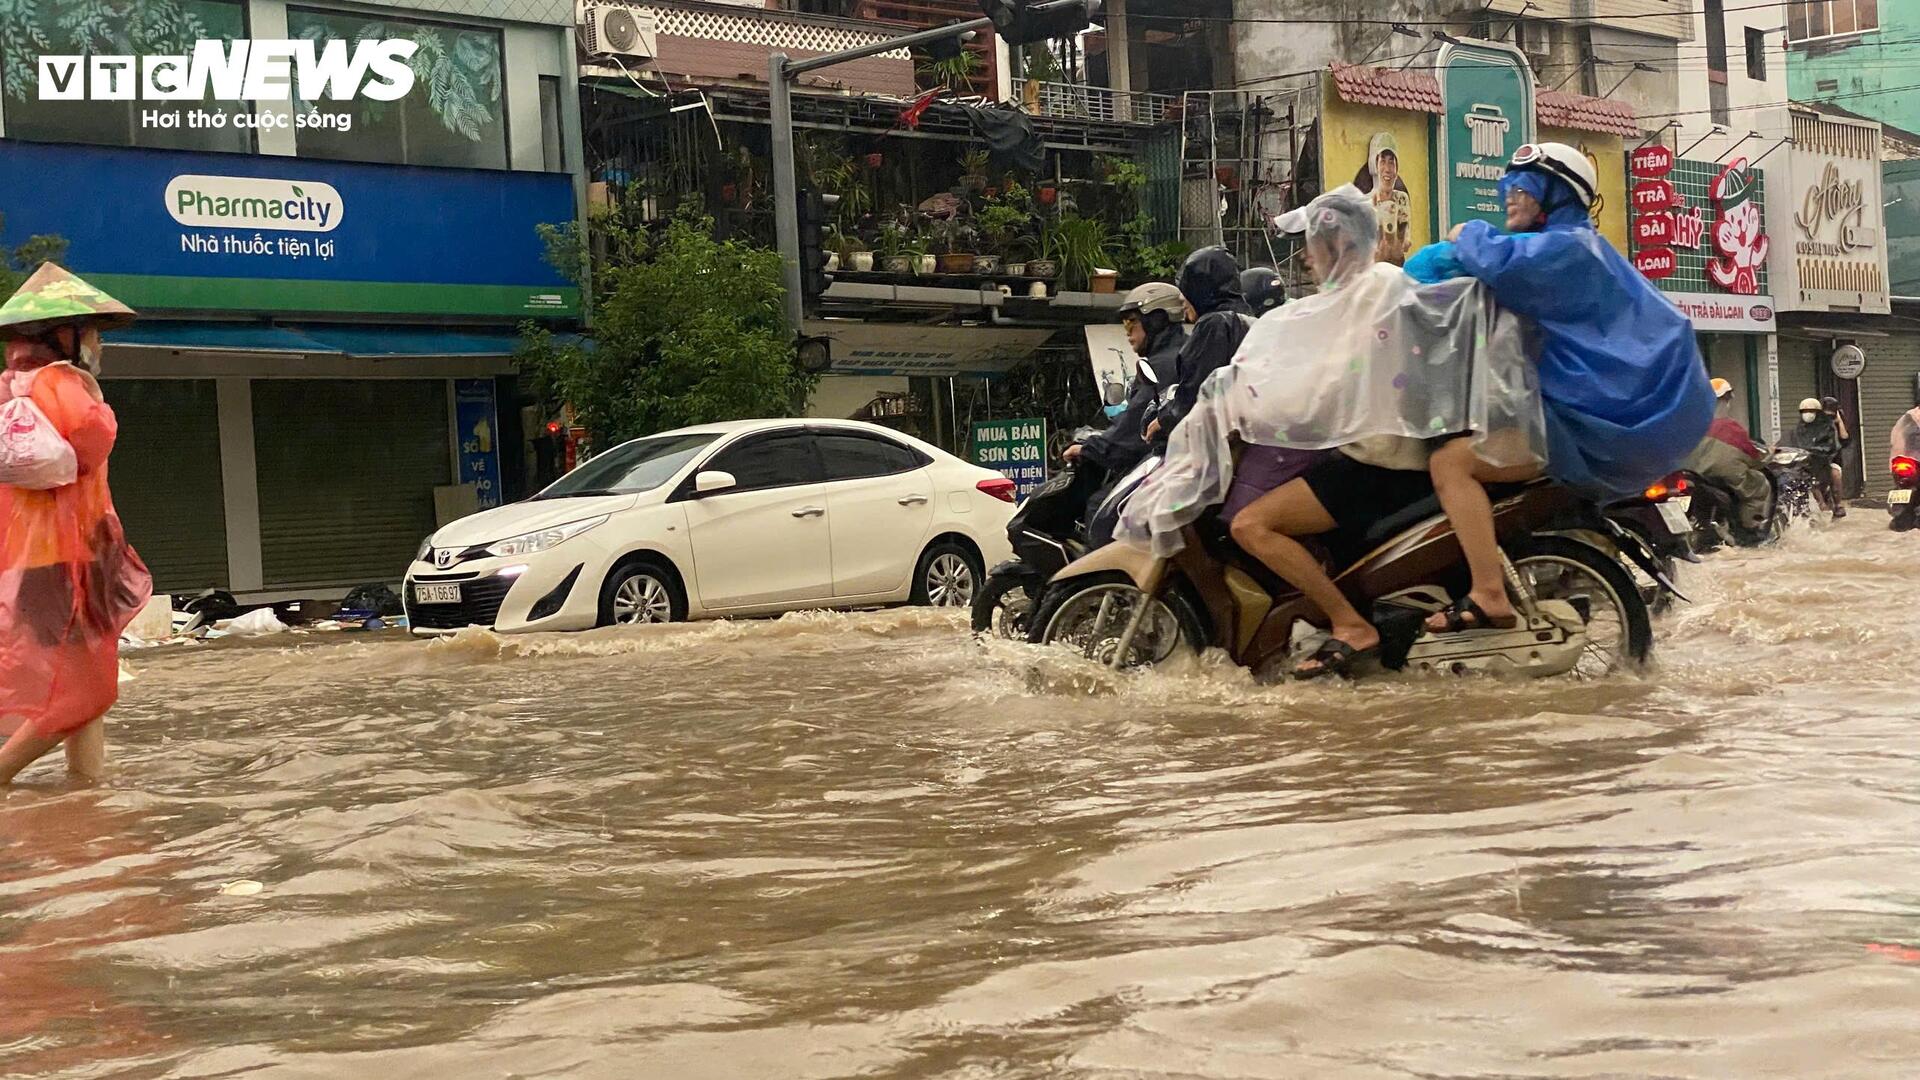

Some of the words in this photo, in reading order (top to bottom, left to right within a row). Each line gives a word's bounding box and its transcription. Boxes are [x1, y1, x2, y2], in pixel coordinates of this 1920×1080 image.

[1634, 152, 1668, 171] TIỆM
[1636, 186, 1666, 203] TRÀ
[177, 187, 332, 228] Pharmacity
[1640, 219, 1666, 237] ĐÀI
[181, 233, 219, 253] Nhà
[223, 233, 274, 255] thuốc
[278, 236, 310, 260] tiện
[315, 238, 334, 260] lợi
[1637, 257, 1670, 271] LOAN
[1692, 301, 1709, 318] TRÀ
[1710, 302, 1722, 319] ĐÀI
[1722, 305, 1744, 319] LOAN
[977, 427, 1008, 442] MUA
[1011, 422, 1040, 440] BÁN
[979, 446, 1008, 462] SƠN
[1011, 442, 1040, 461] SỬA
[1021, 465, 1042, 480] ĐIỆN
